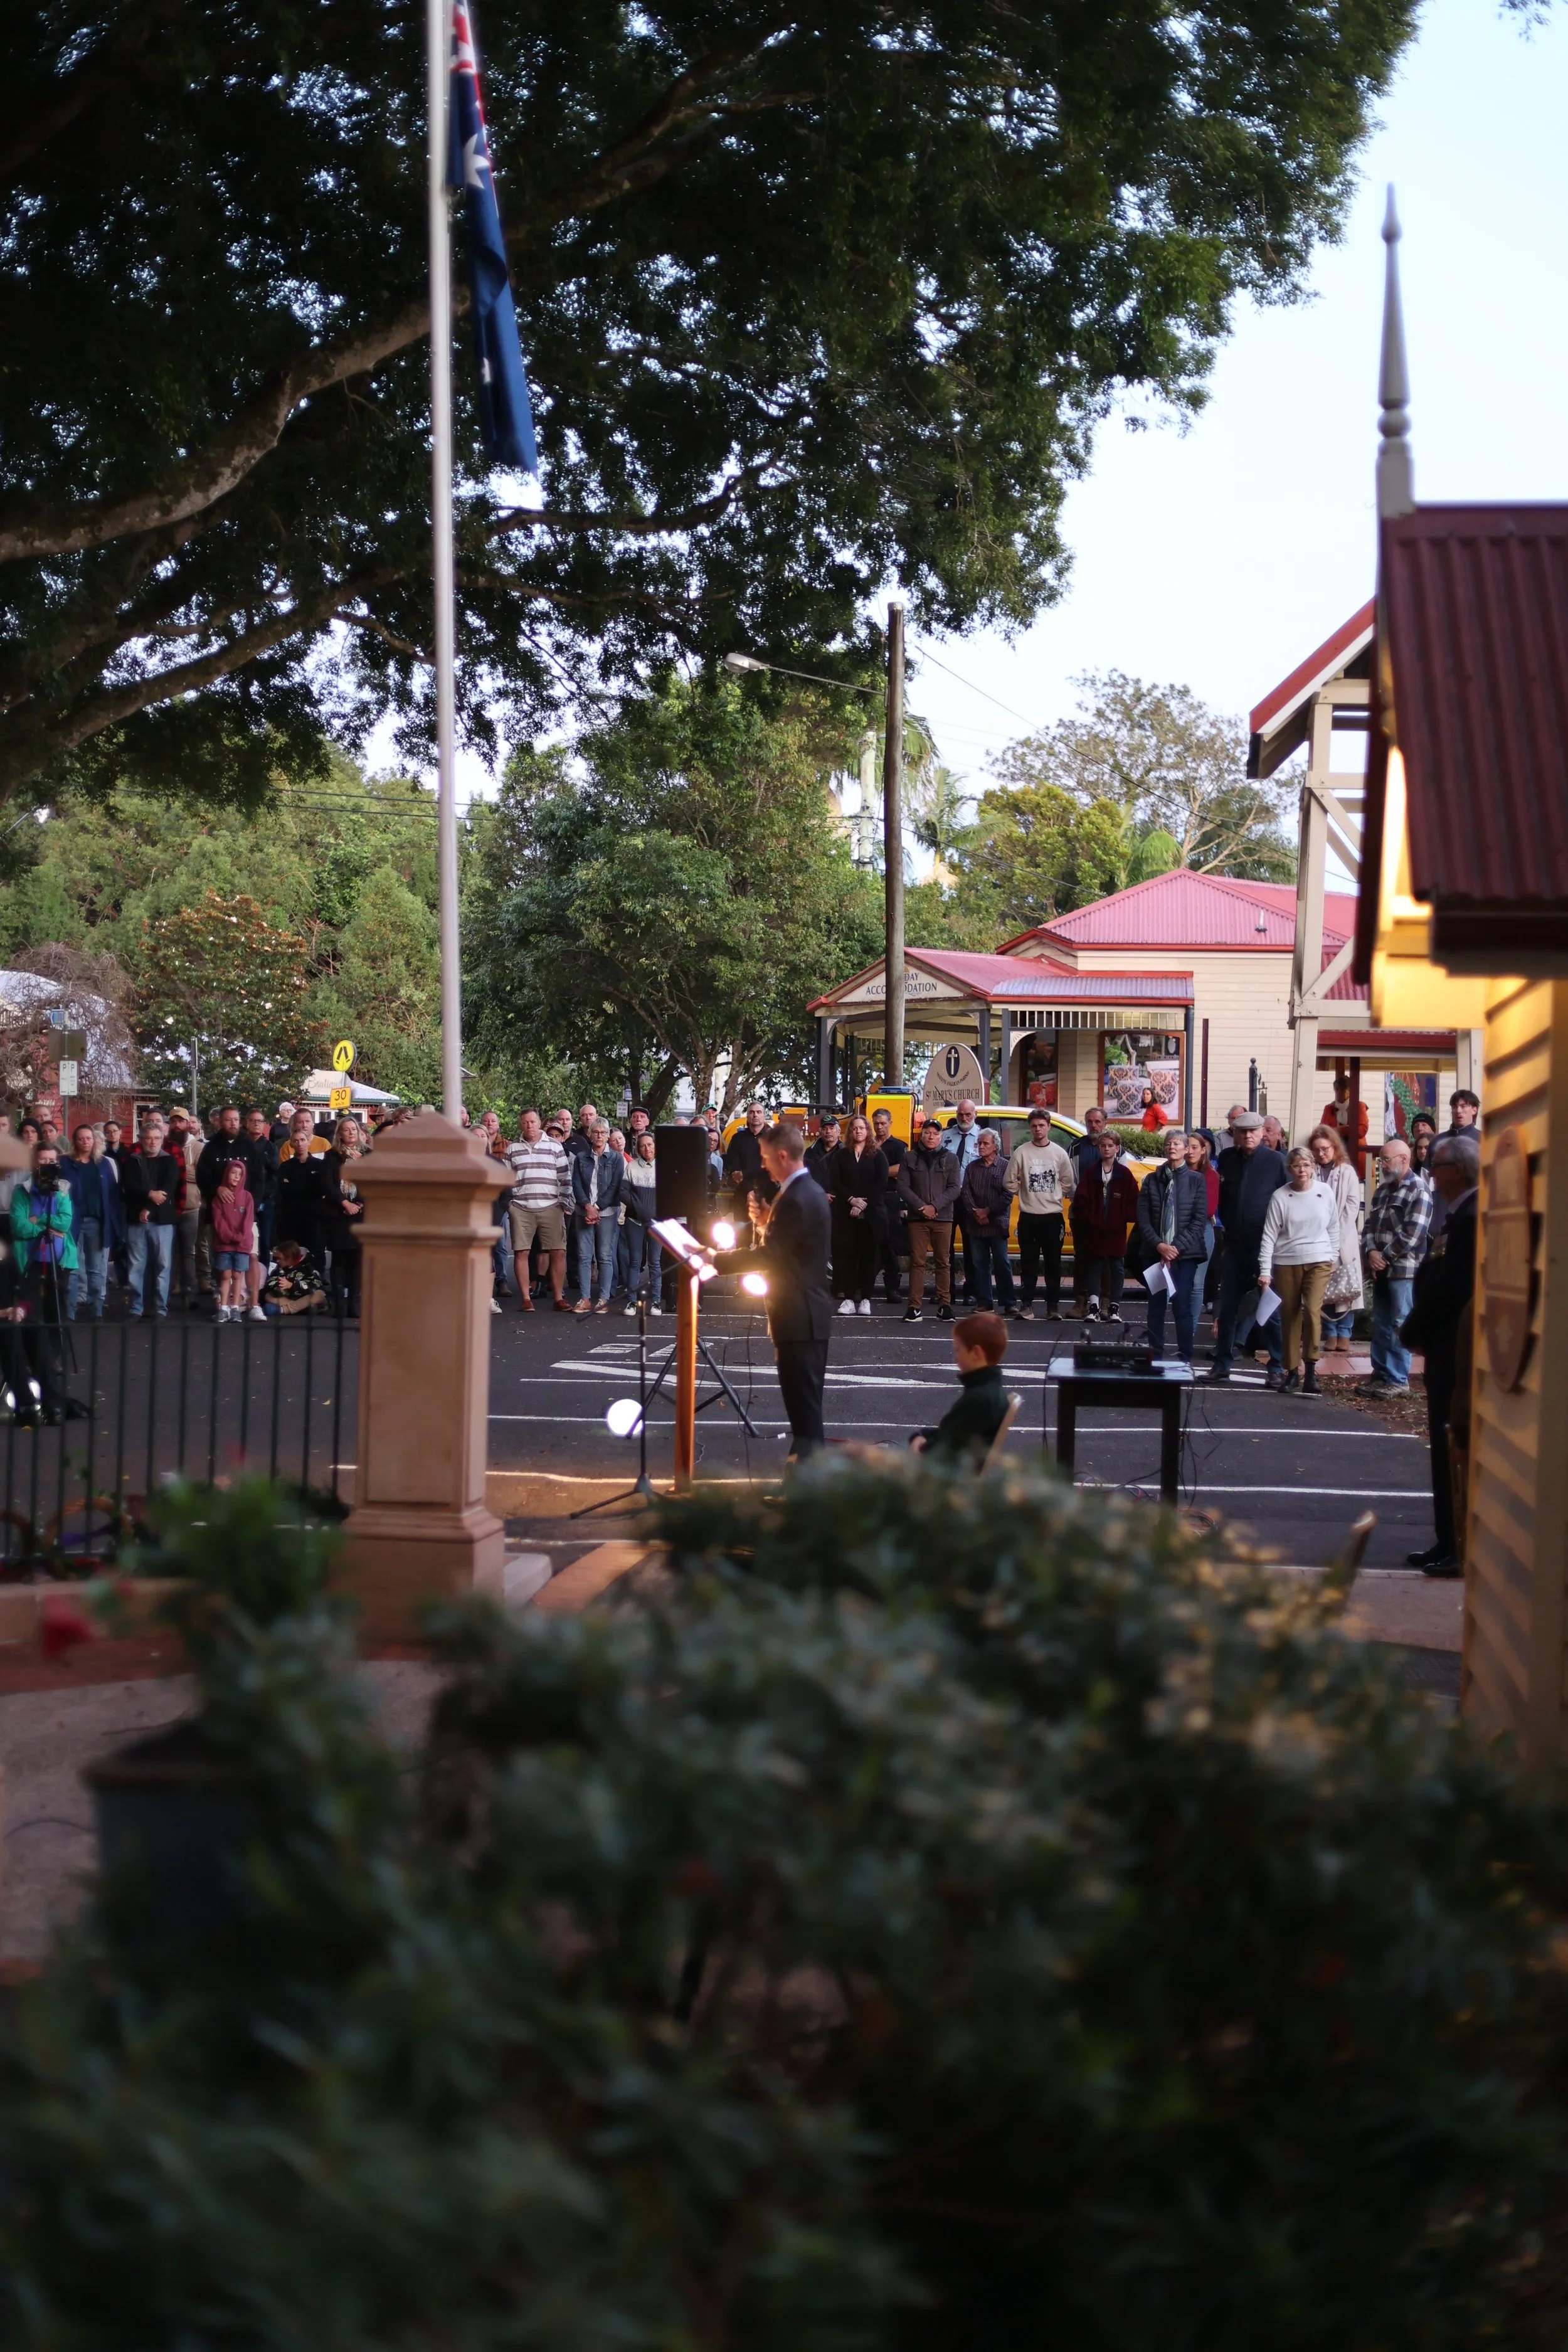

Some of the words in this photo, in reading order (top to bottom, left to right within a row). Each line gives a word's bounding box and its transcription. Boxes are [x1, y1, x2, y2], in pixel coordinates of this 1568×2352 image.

[334, 1089, 346, 1101] 30
[933, 1089, 953, 1101] MARY'S
[953, 1088, 980, 1099] CHURCH
